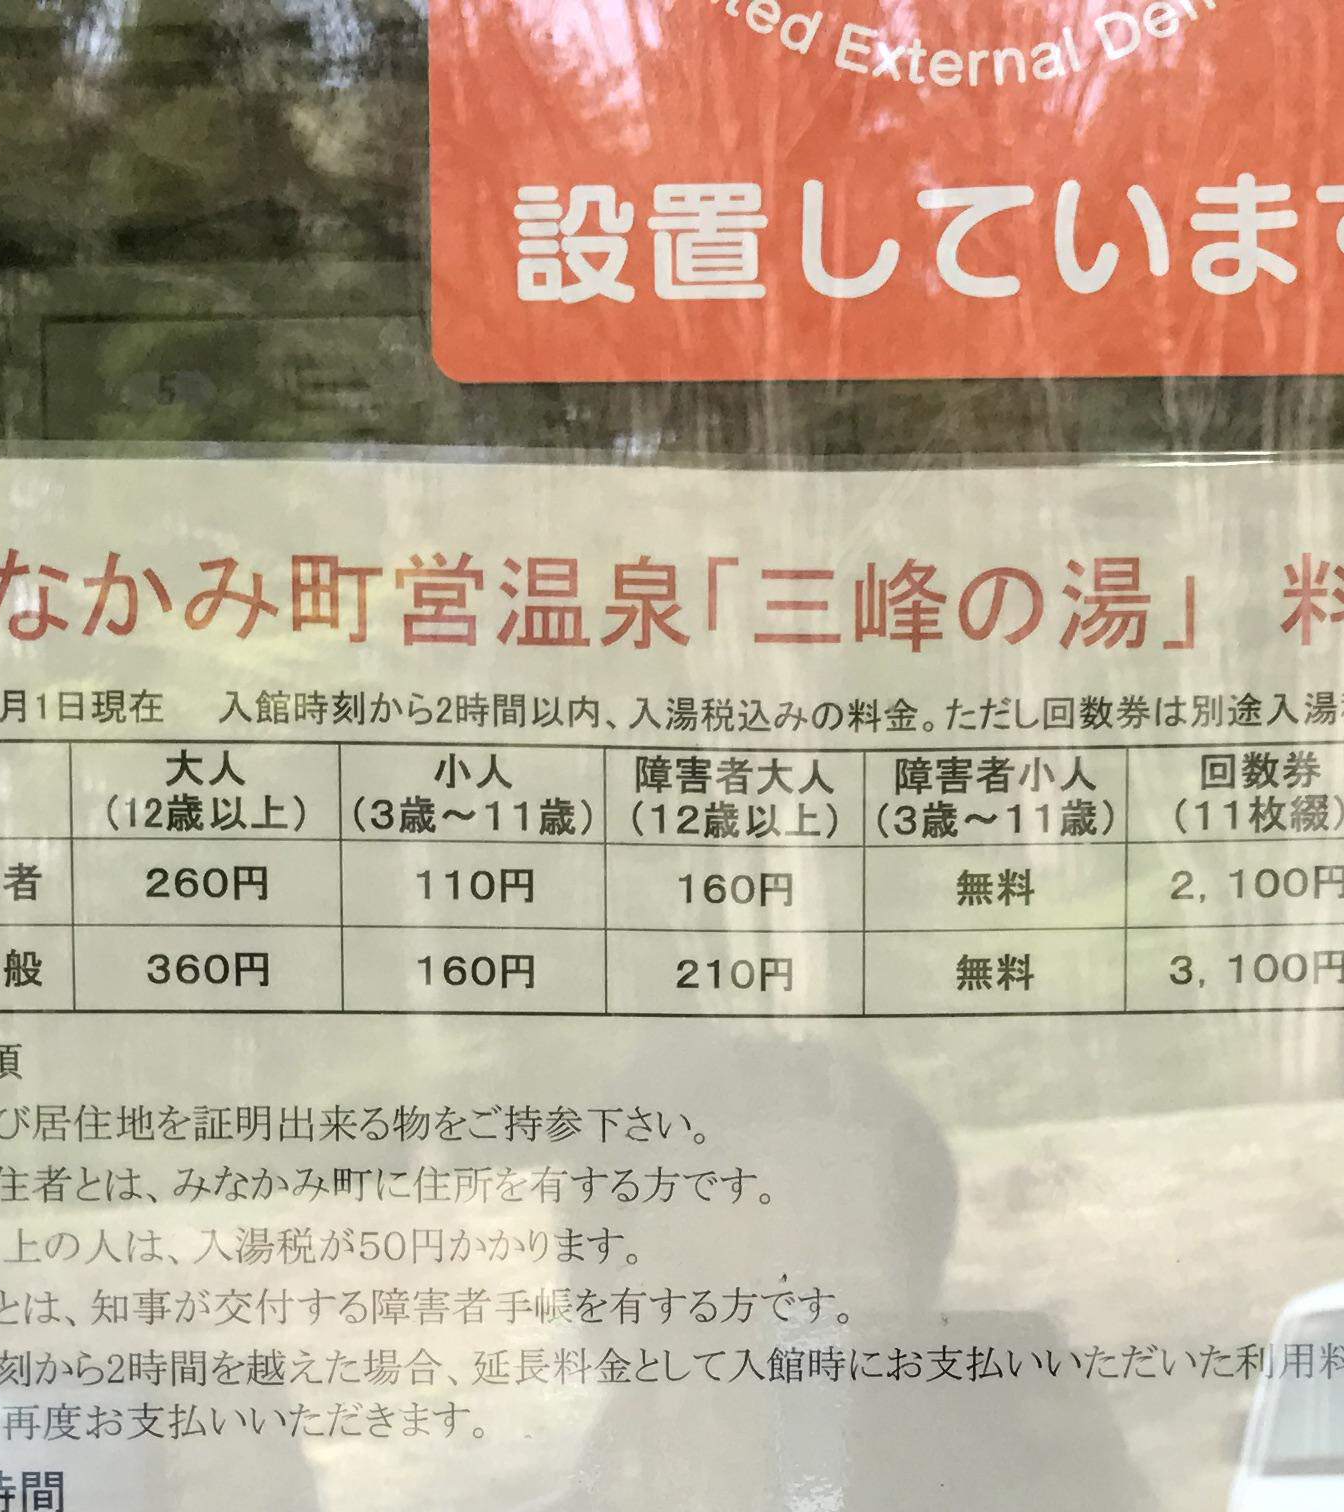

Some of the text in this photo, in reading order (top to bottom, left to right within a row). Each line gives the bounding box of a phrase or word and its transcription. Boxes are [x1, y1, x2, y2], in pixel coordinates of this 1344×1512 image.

[834, 22, 1080, 88] External
[164, 751, 1322, 796] 大人 小人 障害者大人 障害者小人 回数券
[104, 794, 308, 836] (12歳以上)
[630, 801, 840, 841] (12歳以上)
[144, 867, 270, 902] 260円
[415, 867, 537, 904] 110円
[677, 871, 794, 908] 160円
[955, 869, 1035, 908] 無料
[145, 953, 271, 988] 360円
[415, 954, 537, 990] 160円
[675, 956, 794, 992] 210円
[955, 954, 1035, 992] 無料
